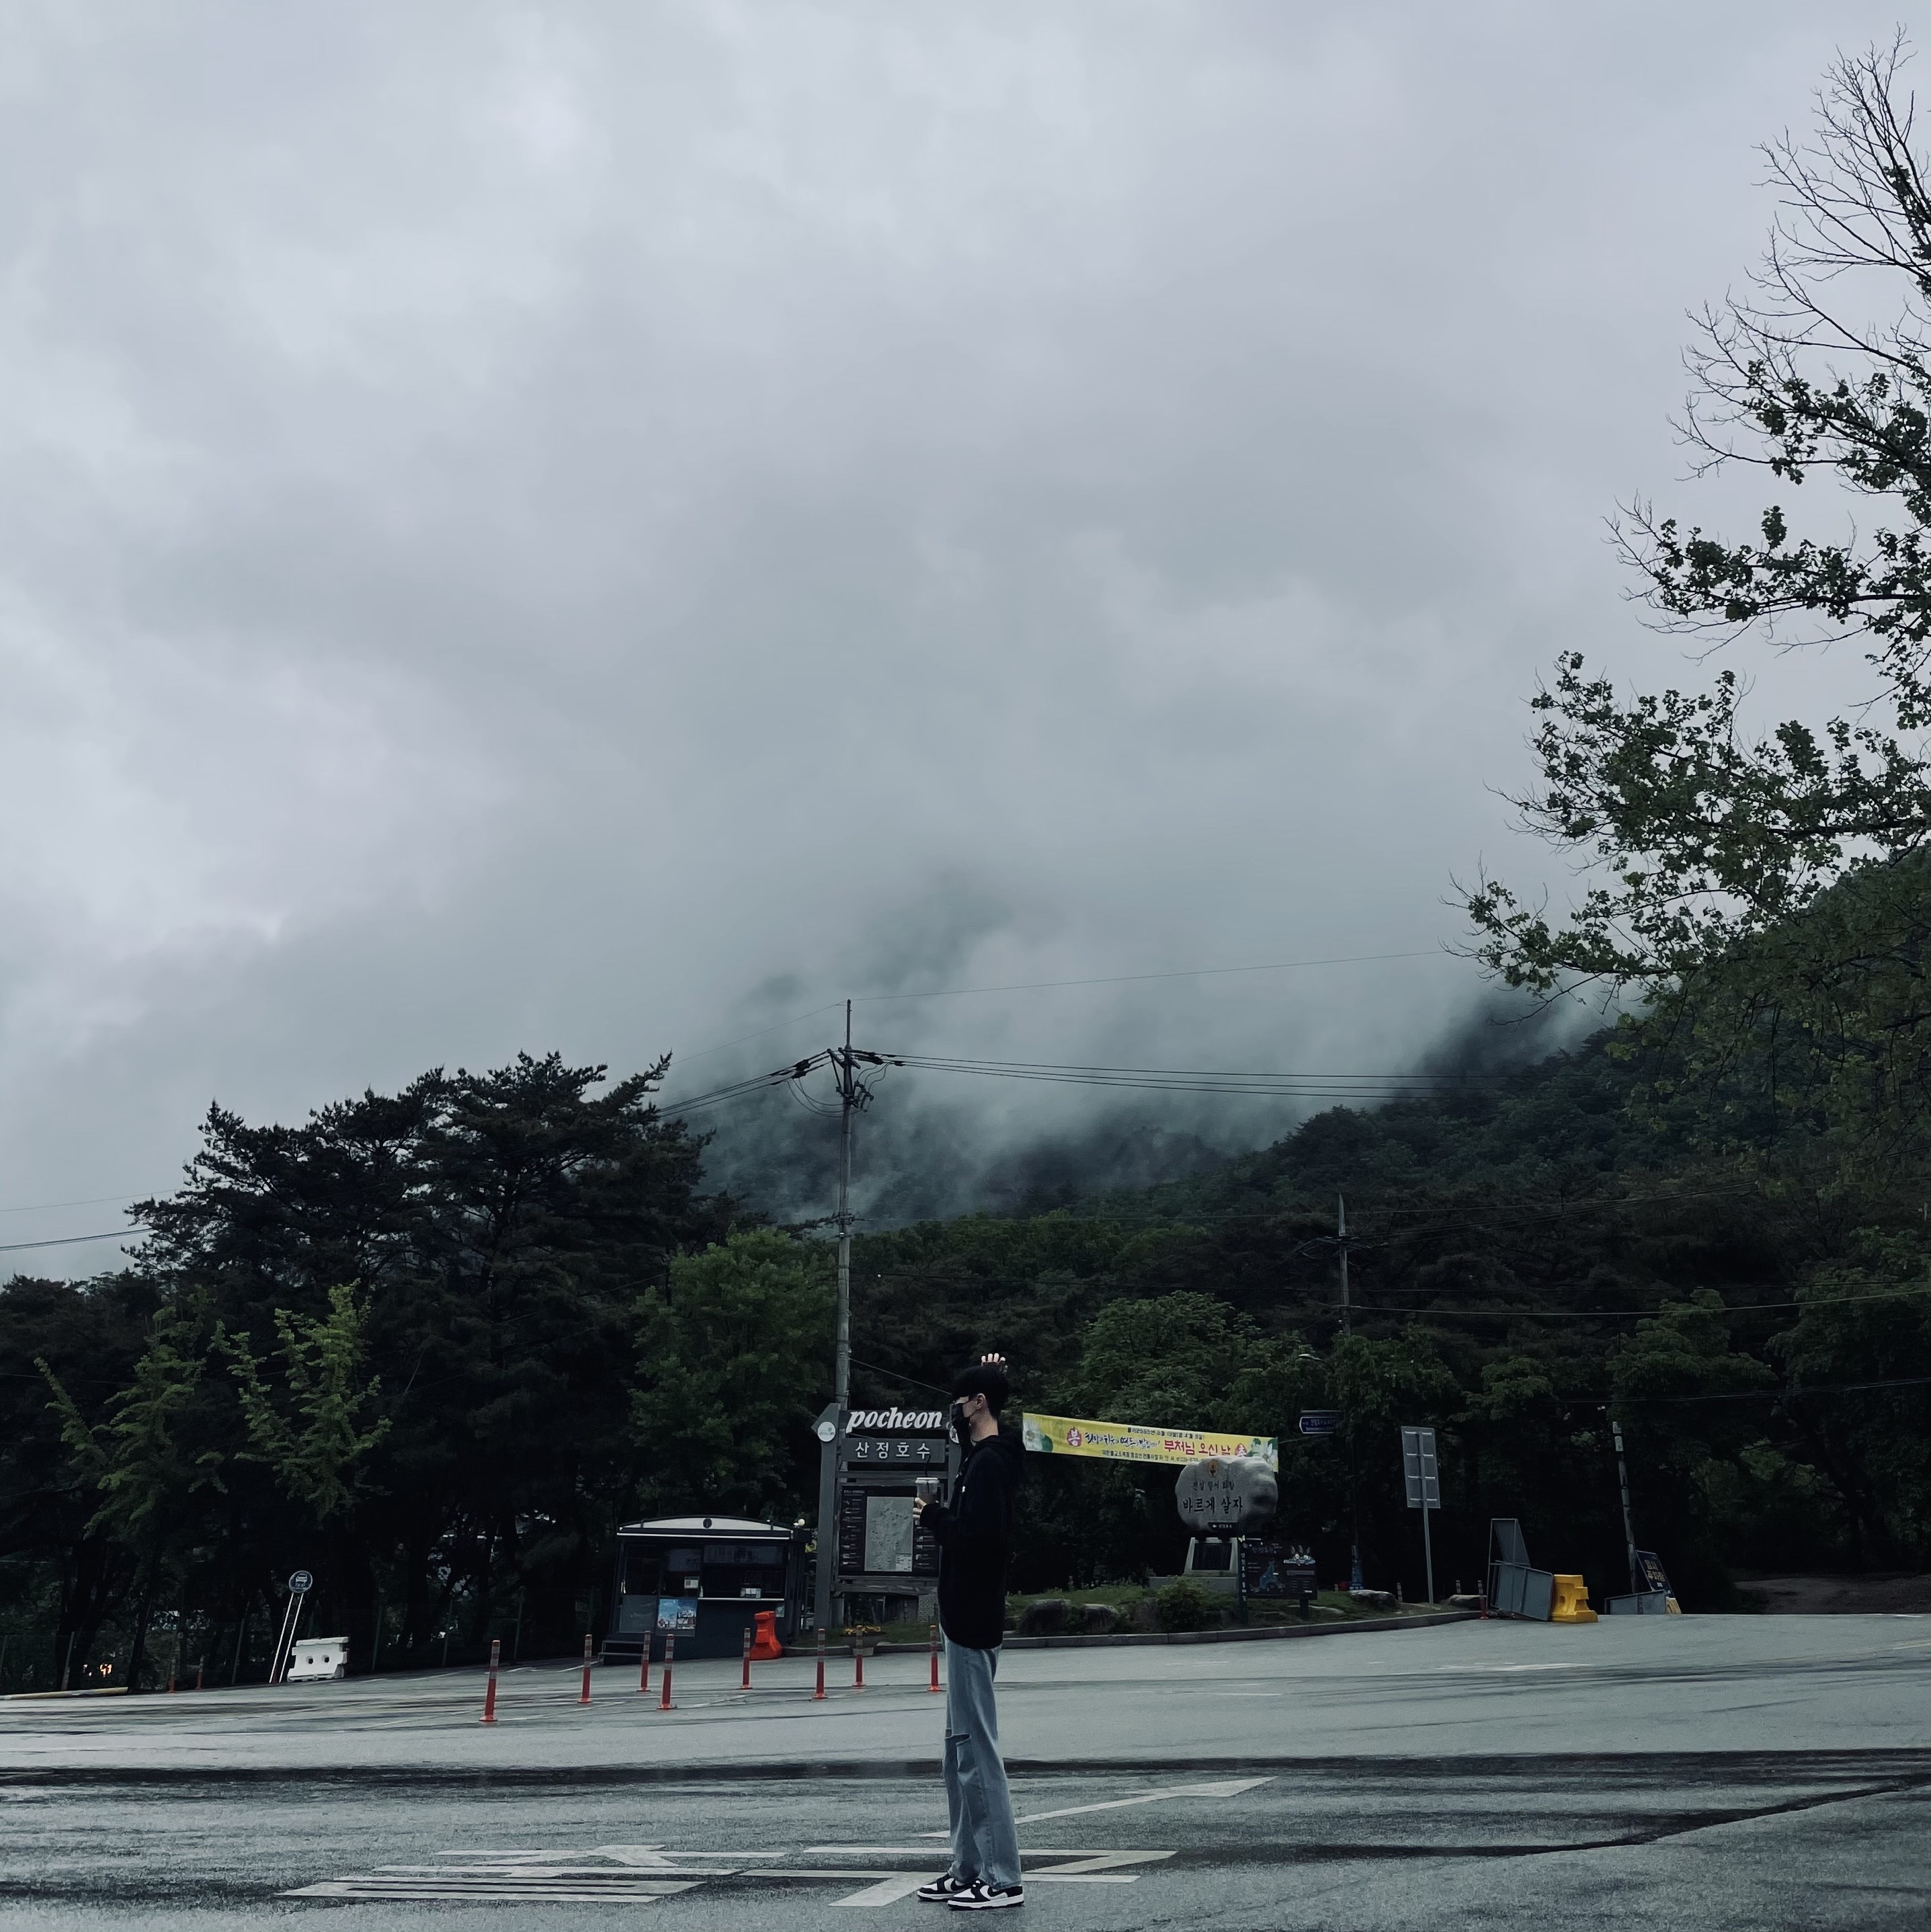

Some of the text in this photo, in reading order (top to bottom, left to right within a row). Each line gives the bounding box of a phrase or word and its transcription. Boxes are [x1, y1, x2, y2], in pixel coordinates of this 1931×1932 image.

[846, 1407, 942, 1433] pocheon
[855, 1441, 931, 1459] 산정호수
[1164, 1439, 1195, 1455] 부처님
[1198, 1443, 1218, 1456] 오신
[1183, 1496, 1243, 1514] 바르게 살자
